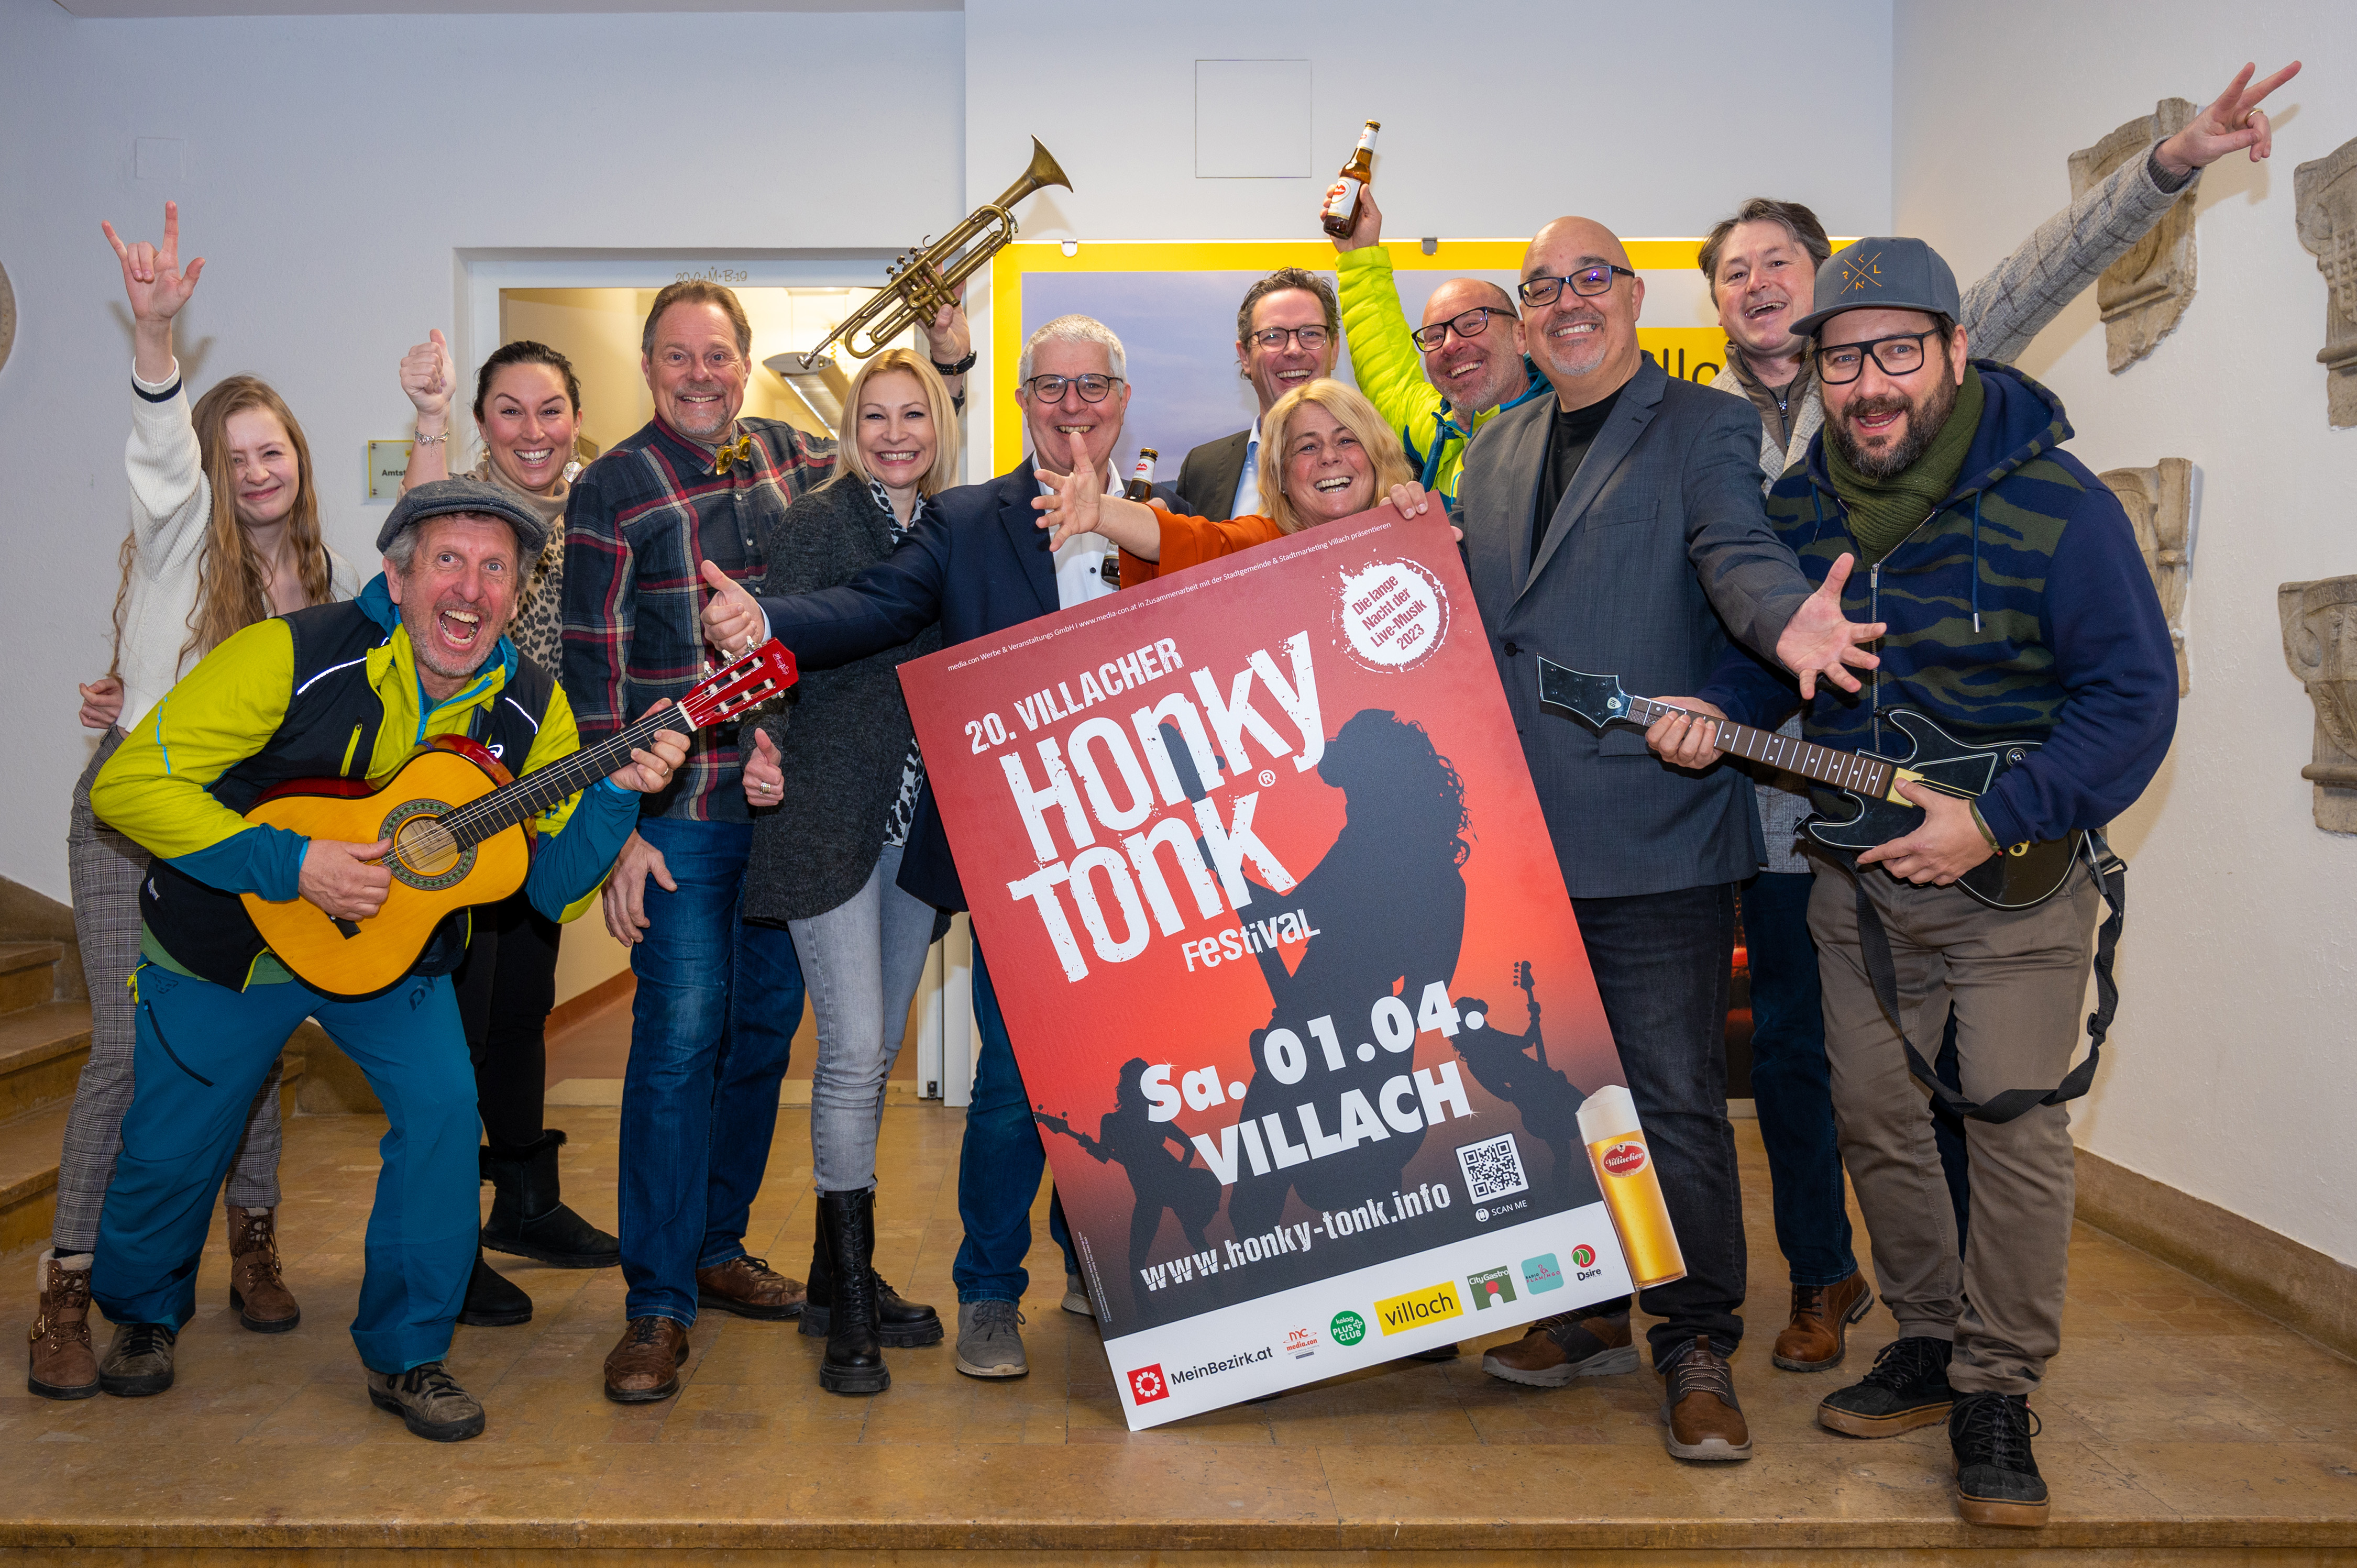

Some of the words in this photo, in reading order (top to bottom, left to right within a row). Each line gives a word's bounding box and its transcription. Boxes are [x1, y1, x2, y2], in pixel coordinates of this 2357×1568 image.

[948, 657, 979, 671] media.con
[980, 648, 1001, 661] Werbe
[1008, 632, 1054, 651] Veranstaltungs
[1054, 624, 1075, 636] GmbH
[1078, 603, 1138, 628] www.media-con.at
[1145, 583, 1198, 606] Zusammenarbeit
[1199, 579, 1211, 588] mit
[1211, 576, 1222, 585] der
[1223, 559, 1272, 580] Stadtgemeinde
[1279, 542, 1328, 562] Stadtmarketing
[1328, 534, 1350, 546] Villach
[1350, 522, 1391, 541] präsentieren
[1351, 597, 1372, 615] Die
[1368, 576, 1398, 602] lange
[1361, 600, 1396, 631] Nacht
[1392, 588, 1411, 607] der
[1370, 599, 1427, 647] Live-Musik
[1396, 623, 1425, 650] 2023
[965, 713, 1017, 755] 20.
[1013, 637, 1185, 733] VILLACHER
[1609, 699, 1617, 708] GH
[1140, 1064, 1247, 1123] Sa.
[1263, 980, 1485, 1085] 01.04.
[1189, 1060, 1472, 1186] VILLACH
[1605, 1152, 1644, 1167] Villacher
[1491, 1206, 1513, 1216] SCAN
[1514, 1199, 1527, 1209] ME
[1140, 1182, 1451, 1292] www.honky-tonk.info
[1576, 1268, 1602, 1282] Dsire
[1336, 1316, 1354, 1324] kelag
[1385, 1292, 1454, 1326] villach
[1286, 1339, 1318, 1351] media.con
[1332, 1324, 1353, 1335] PLUS
[1339, 1330, 1362, 1341] CLUB
[1171, 1346, 1273, 1385] MeinBezirk.at
